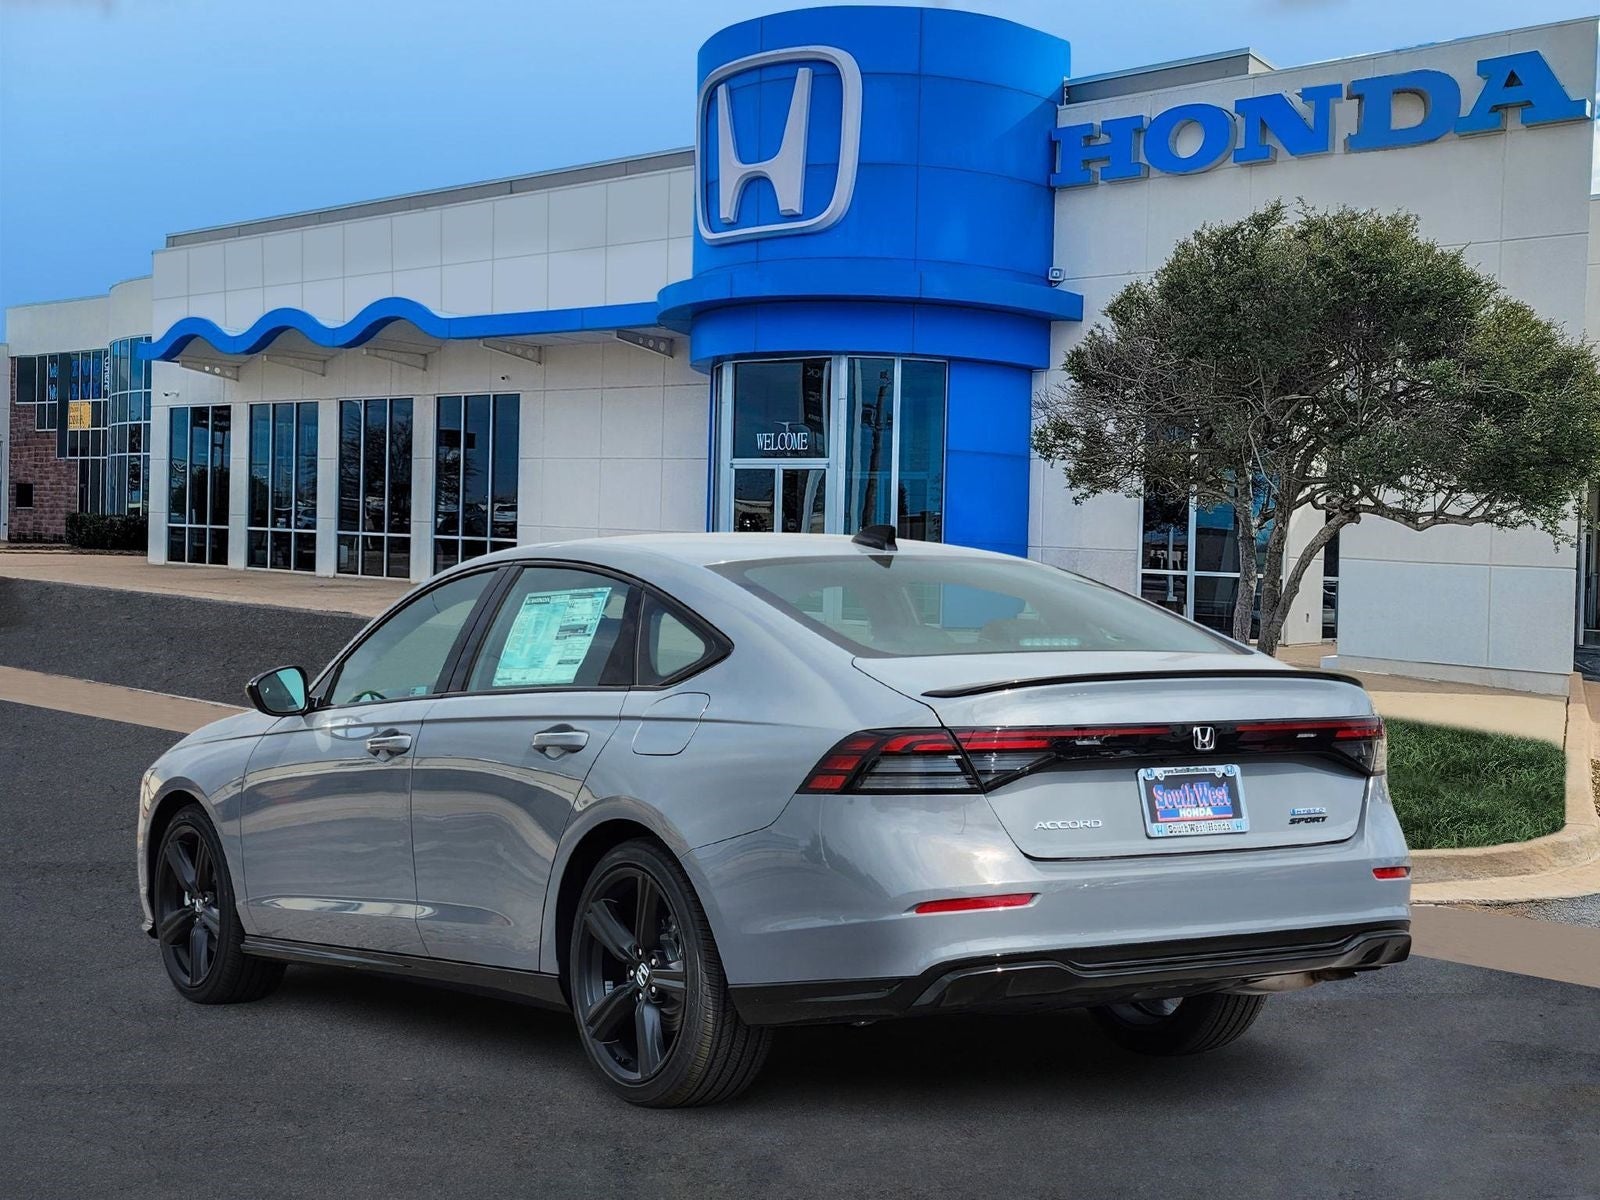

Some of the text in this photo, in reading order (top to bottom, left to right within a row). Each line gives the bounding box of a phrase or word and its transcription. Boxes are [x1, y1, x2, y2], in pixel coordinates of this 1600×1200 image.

[1050, 50, 1592, 188] HONDA
[756, 432, 808, 451] WELCOME
[1179, 807, 1214, 818] HONDA
[1034, 819, 1103, 830] ACCORD
[1288, 816, 1328, 825] SPORT
[1208, 823, 1231, 833] Honda
